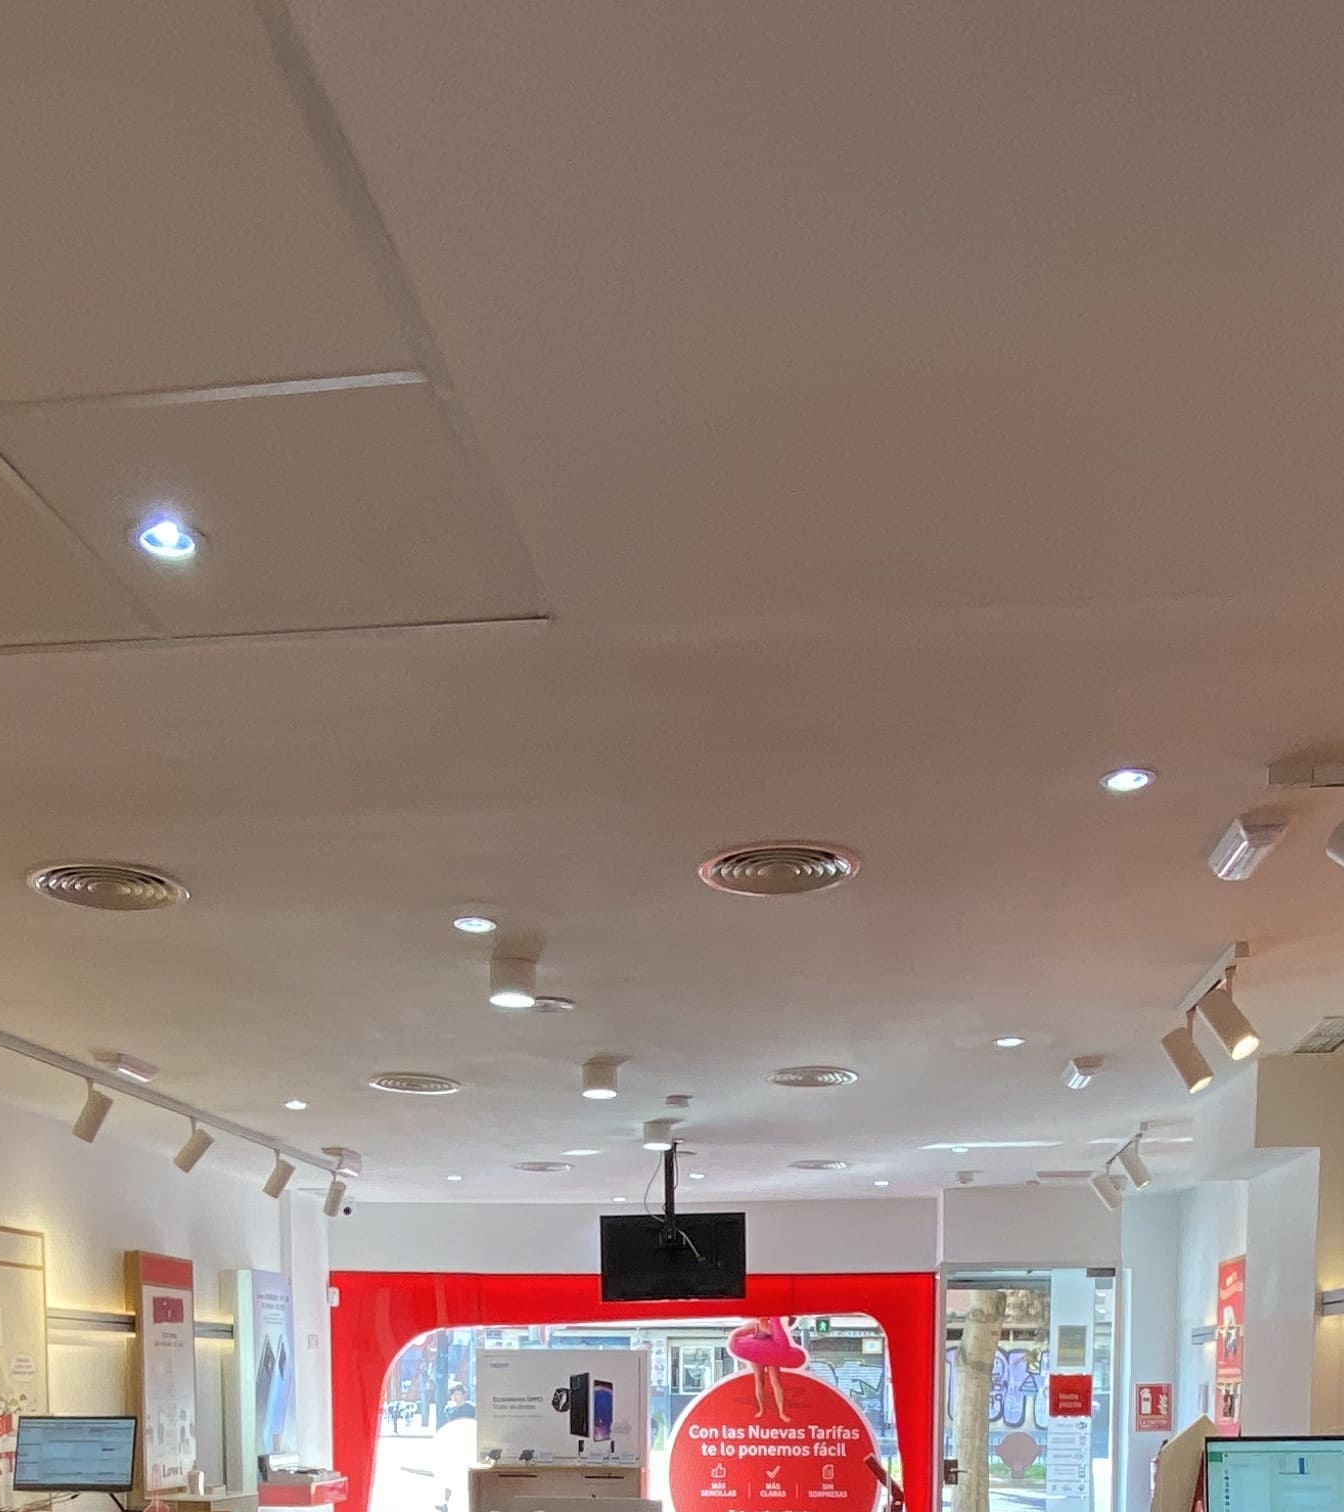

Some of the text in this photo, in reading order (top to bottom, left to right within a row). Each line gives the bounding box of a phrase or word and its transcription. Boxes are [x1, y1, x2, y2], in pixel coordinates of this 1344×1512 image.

[689, 1425, 860, 1439] Con las Nuevas Tarifas
[701, 1442, 847, 1459] te lo ponemos fácil
[162, 1463, 183, 1478] Lowi
